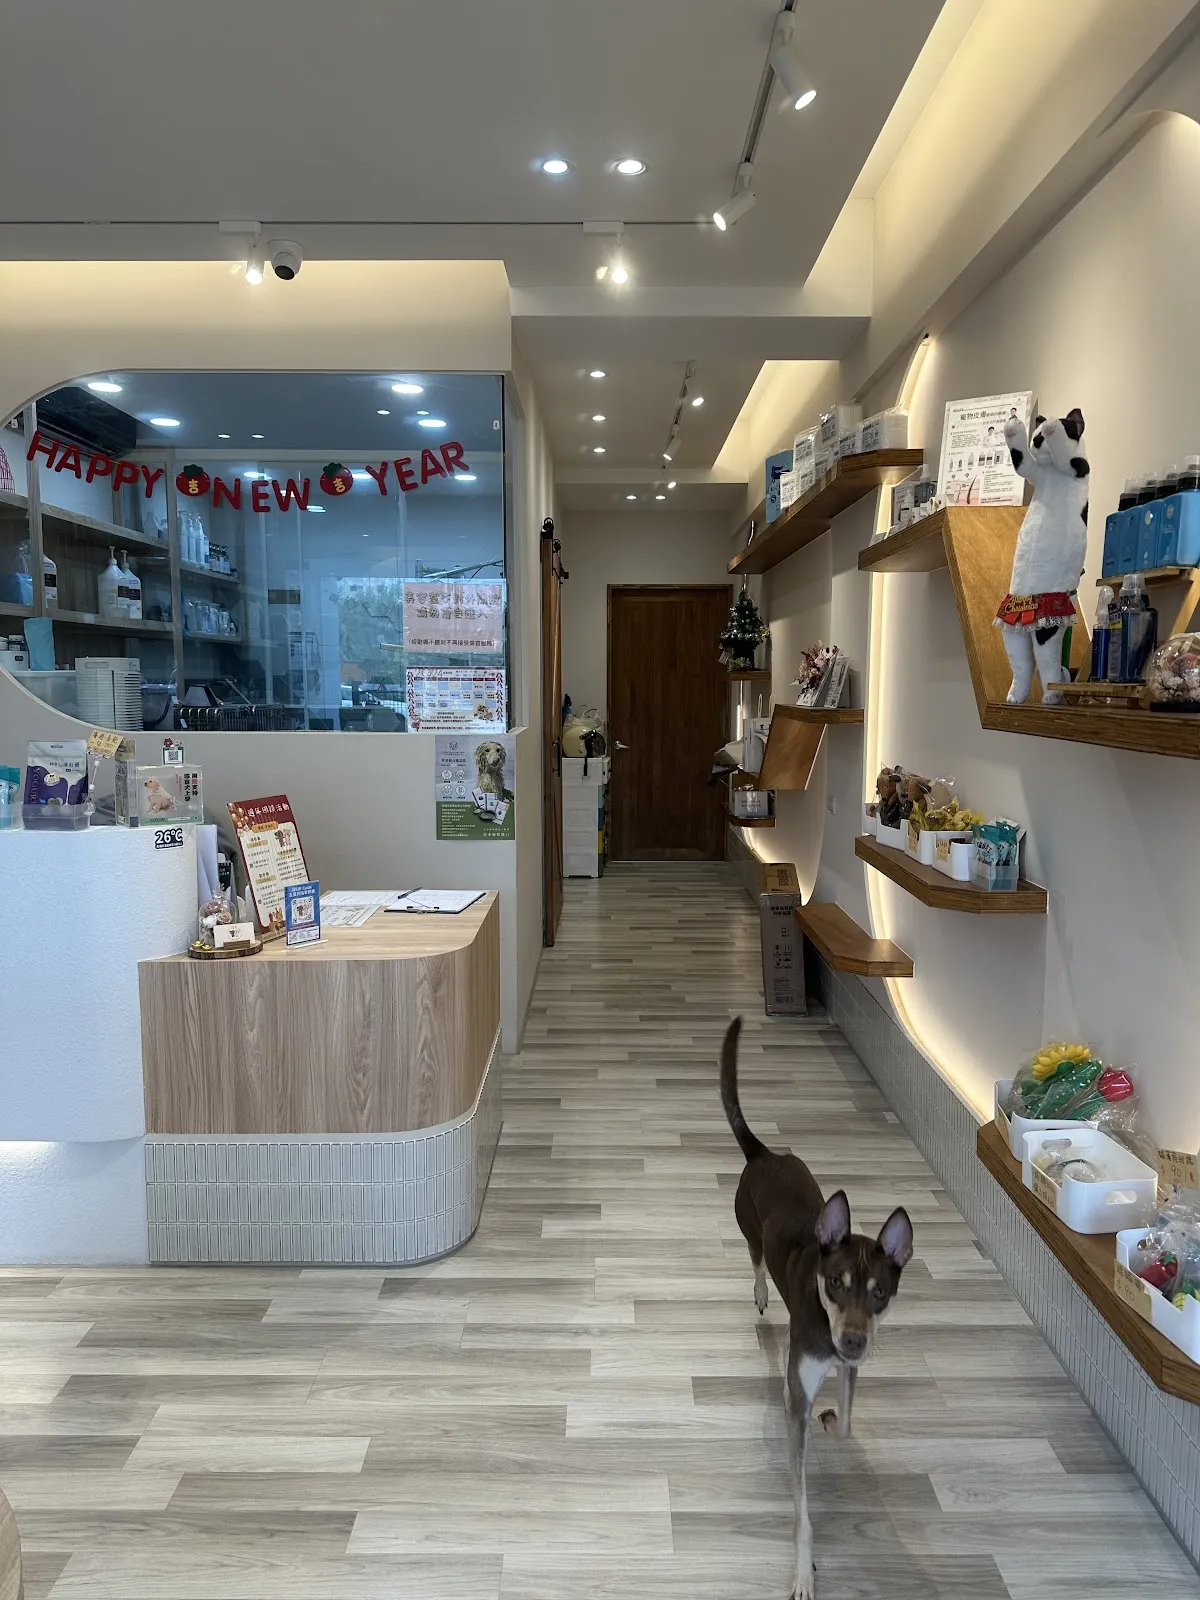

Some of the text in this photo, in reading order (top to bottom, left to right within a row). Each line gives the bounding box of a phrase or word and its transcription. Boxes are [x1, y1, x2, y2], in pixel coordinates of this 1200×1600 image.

[27, 430, 470, 512] HAPPY NEW YEAR
[188, 478, 199, 494] 吉
[332, 477, 346, 493] 吉
[29, 767, 41, 804] YOGURT
[155, 828, 183, 844] 26°C
